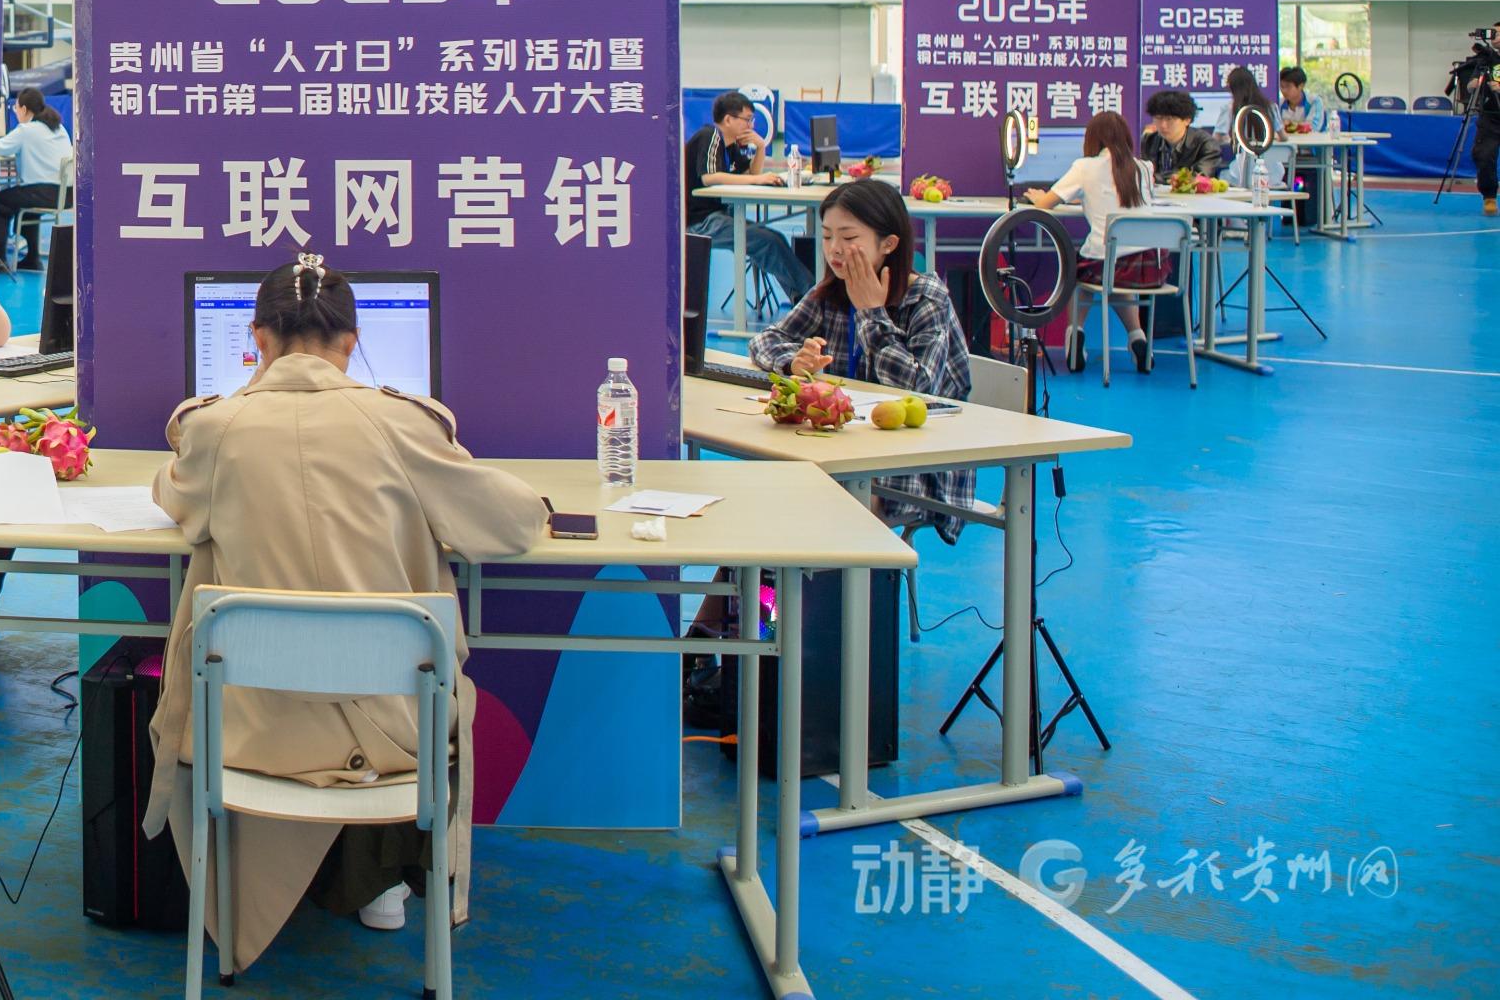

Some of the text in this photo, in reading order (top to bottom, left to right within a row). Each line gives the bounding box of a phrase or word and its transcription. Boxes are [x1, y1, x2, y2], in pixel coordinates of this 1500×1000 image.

[1160, 7, 1244, 29] 2025年
[1141, 34, 1270, 44] 州省“人才日”系列活动暨
[1141, 45, 1270, 55] 仁市第二届职业技能人才大赛
[917, 51, 1128, 68] 铜仁市第二届职业技能人才大赛
[109, 80, 645, 116] 铜仁市第二届职业技能人才大赛
[919, 80, 1124, 120] 互联网营销
[120, 155, 636, 248] 互联网营销
